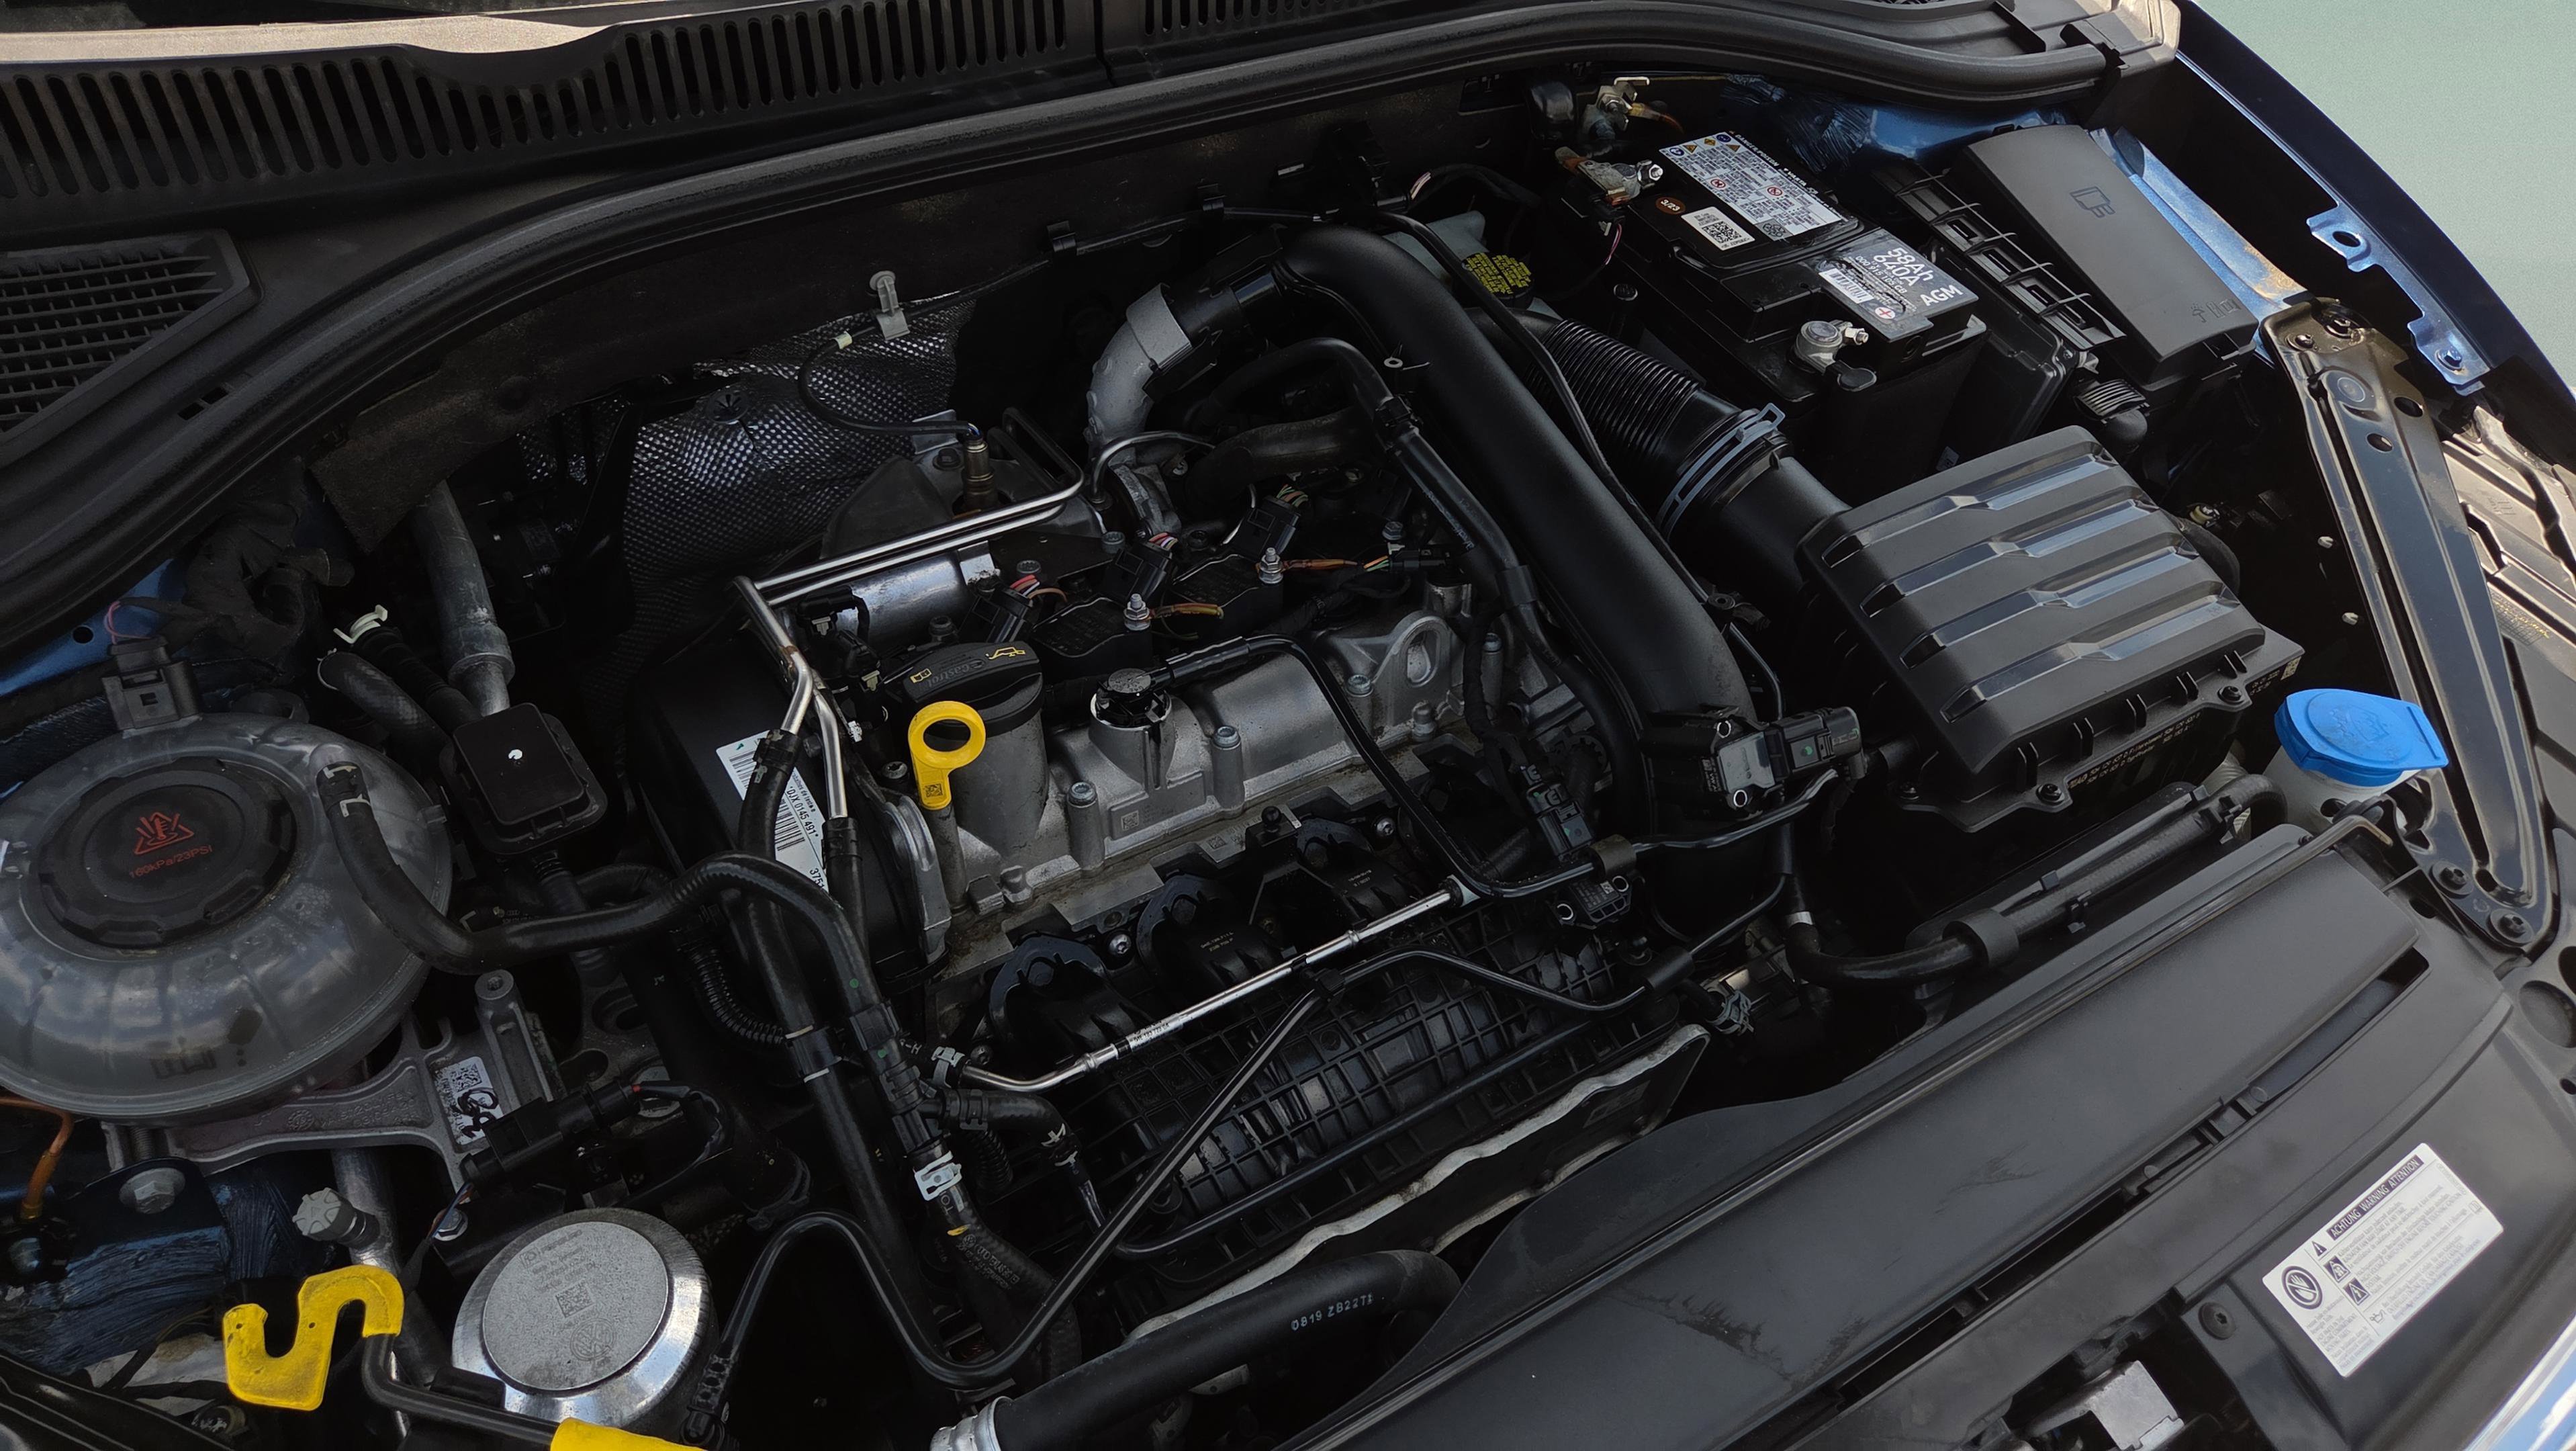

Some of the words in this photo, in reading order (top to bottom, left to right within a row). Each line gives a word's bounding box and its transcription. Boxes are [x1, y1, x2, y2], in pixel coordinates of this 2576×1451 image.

[1659, 199, 1681, 212] 3/23
[1868, 265, 1883, 276] 915
[1881, 275, 1896, 285] 105
[1874, 255, 1920, 286] 640A
[1887, 247, 1933, 281] 58Ah
[1921, 283, 1964, 306] AGM
[795, 801, 810, 820] 0145
[2330, 1208, 2362, 1237] ACHTUNG
[2358, 1184, 2390, 1212] WARNING
[2387, 1157, 2420, 1188] ATTENTION
[1291, 1310, 1324, 1333] 0819
